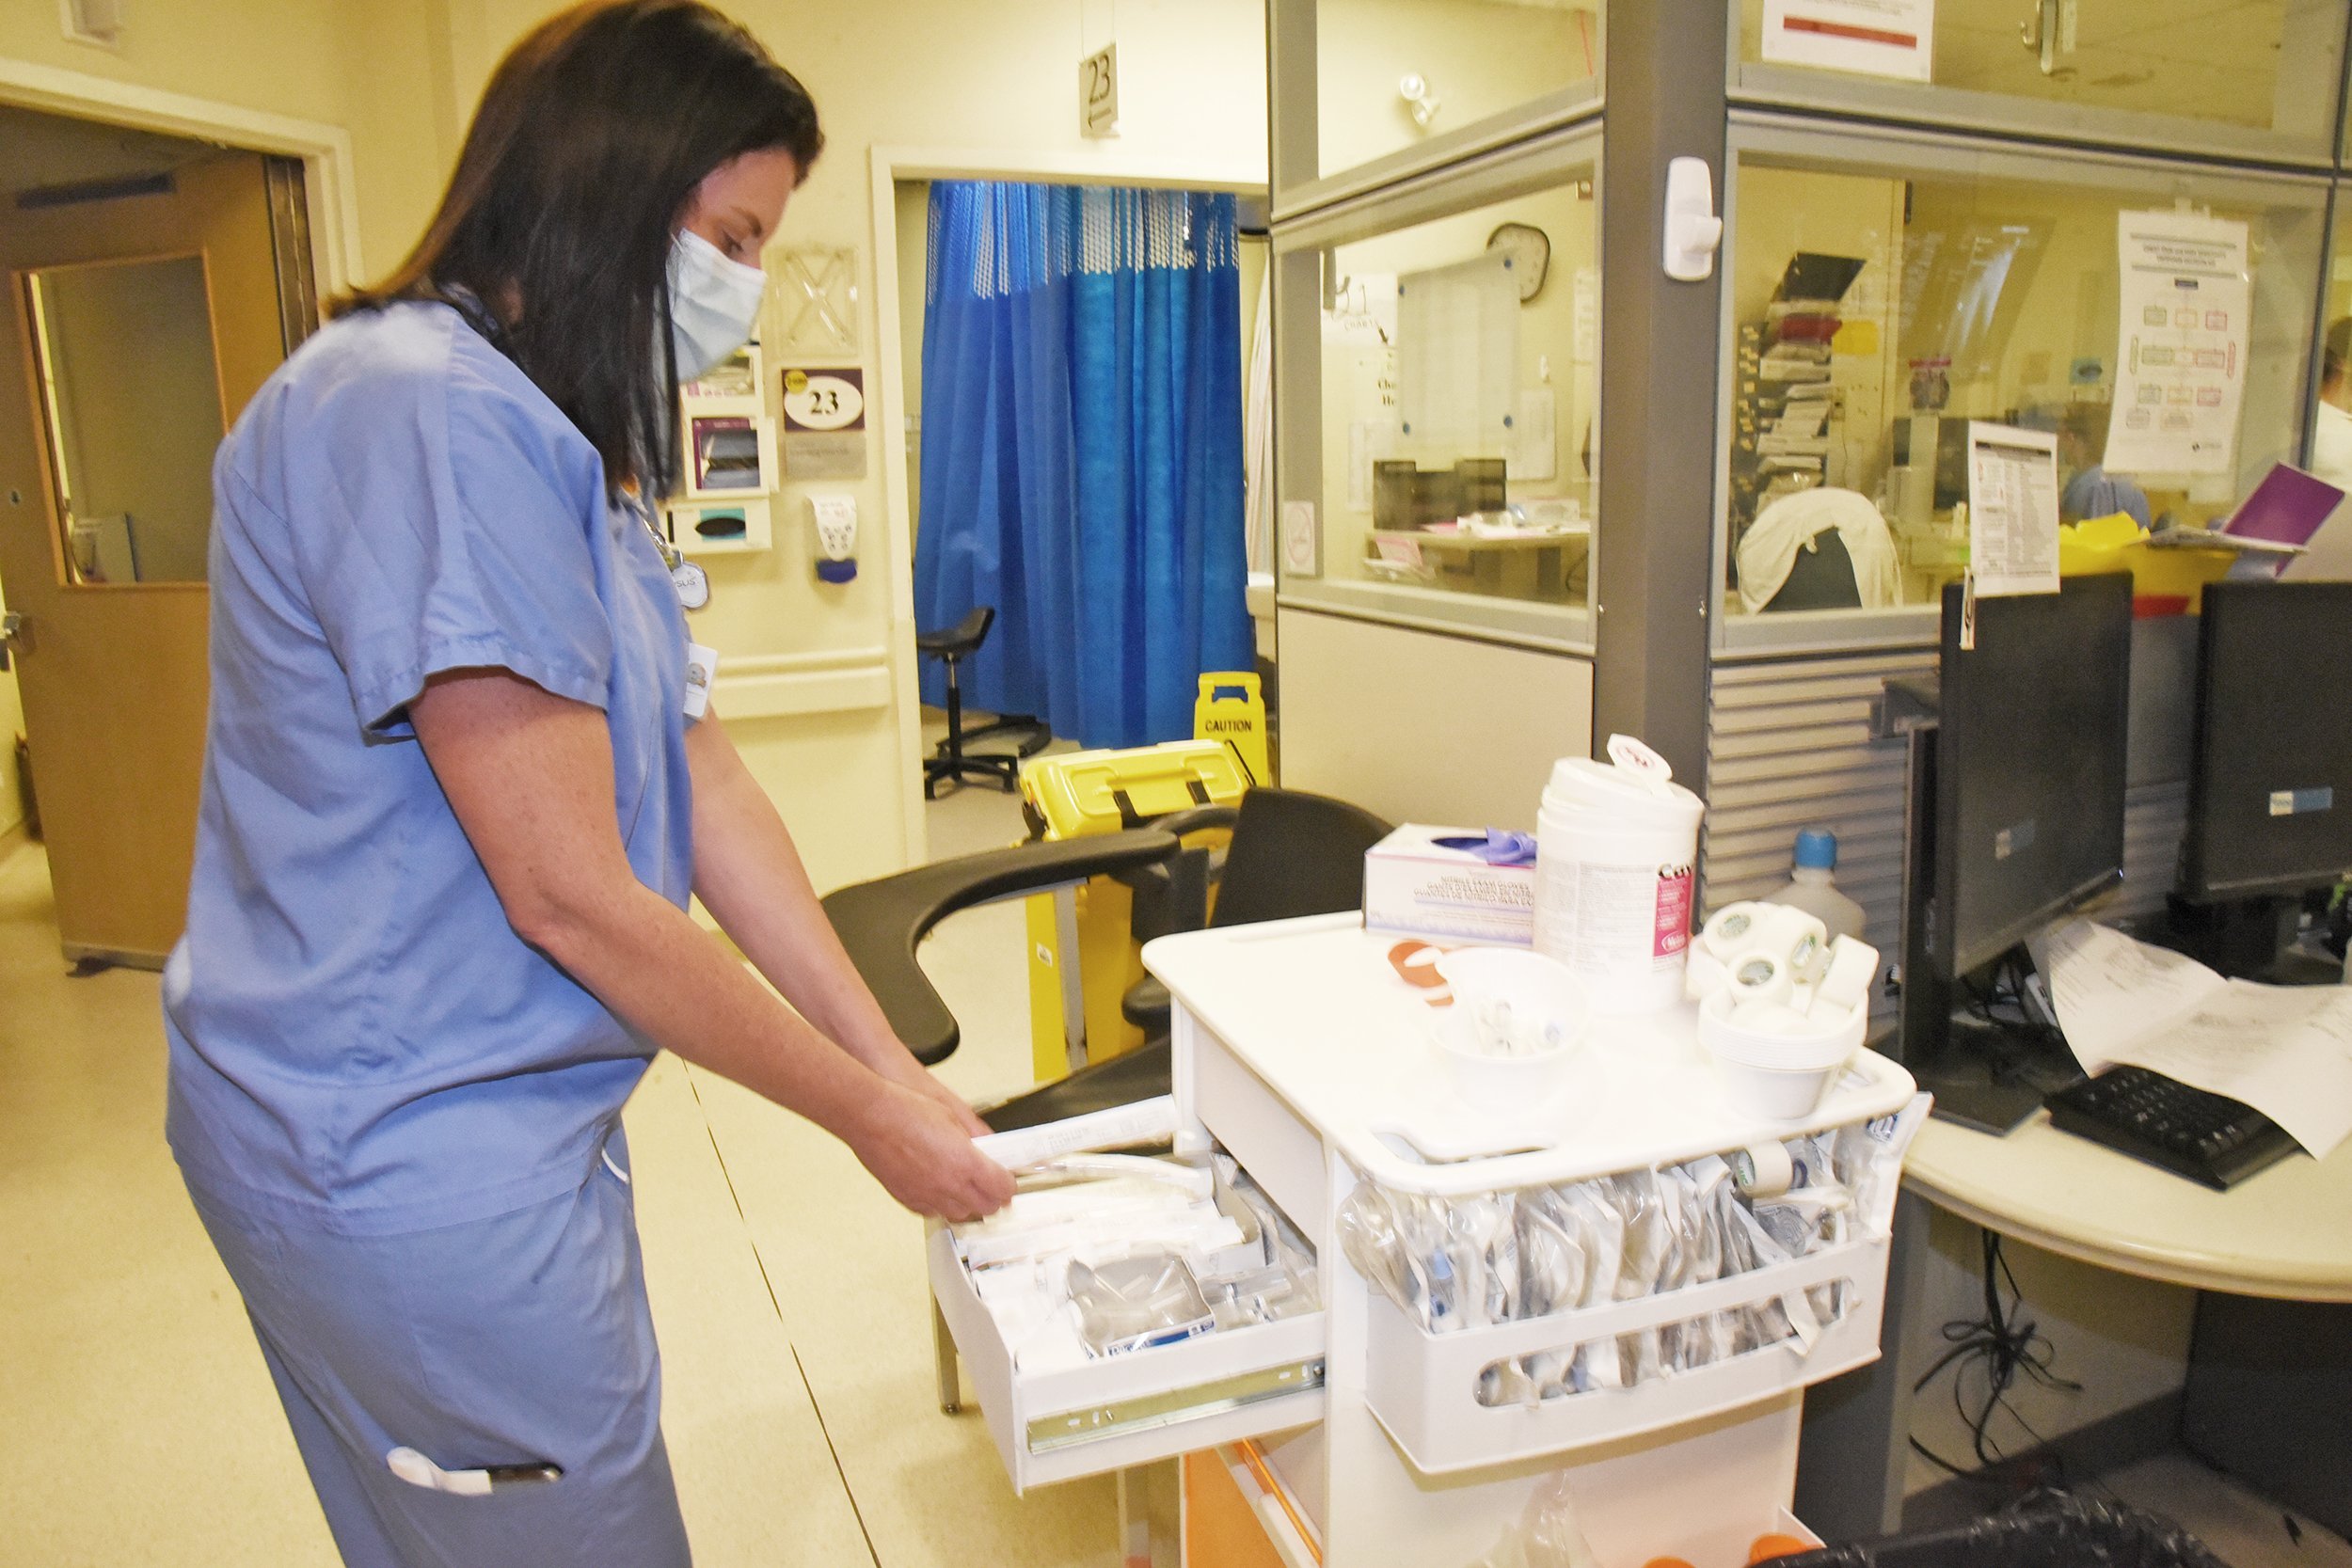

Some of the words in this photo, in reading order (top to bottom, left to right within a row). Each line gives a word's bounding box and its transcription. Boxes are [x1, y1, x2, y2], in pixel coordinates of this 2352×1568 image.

[1088, 54, 1110, 105] 23
[809, 388, 839, 415] 23
[1205, 721, 1252, 732] CAUTION
